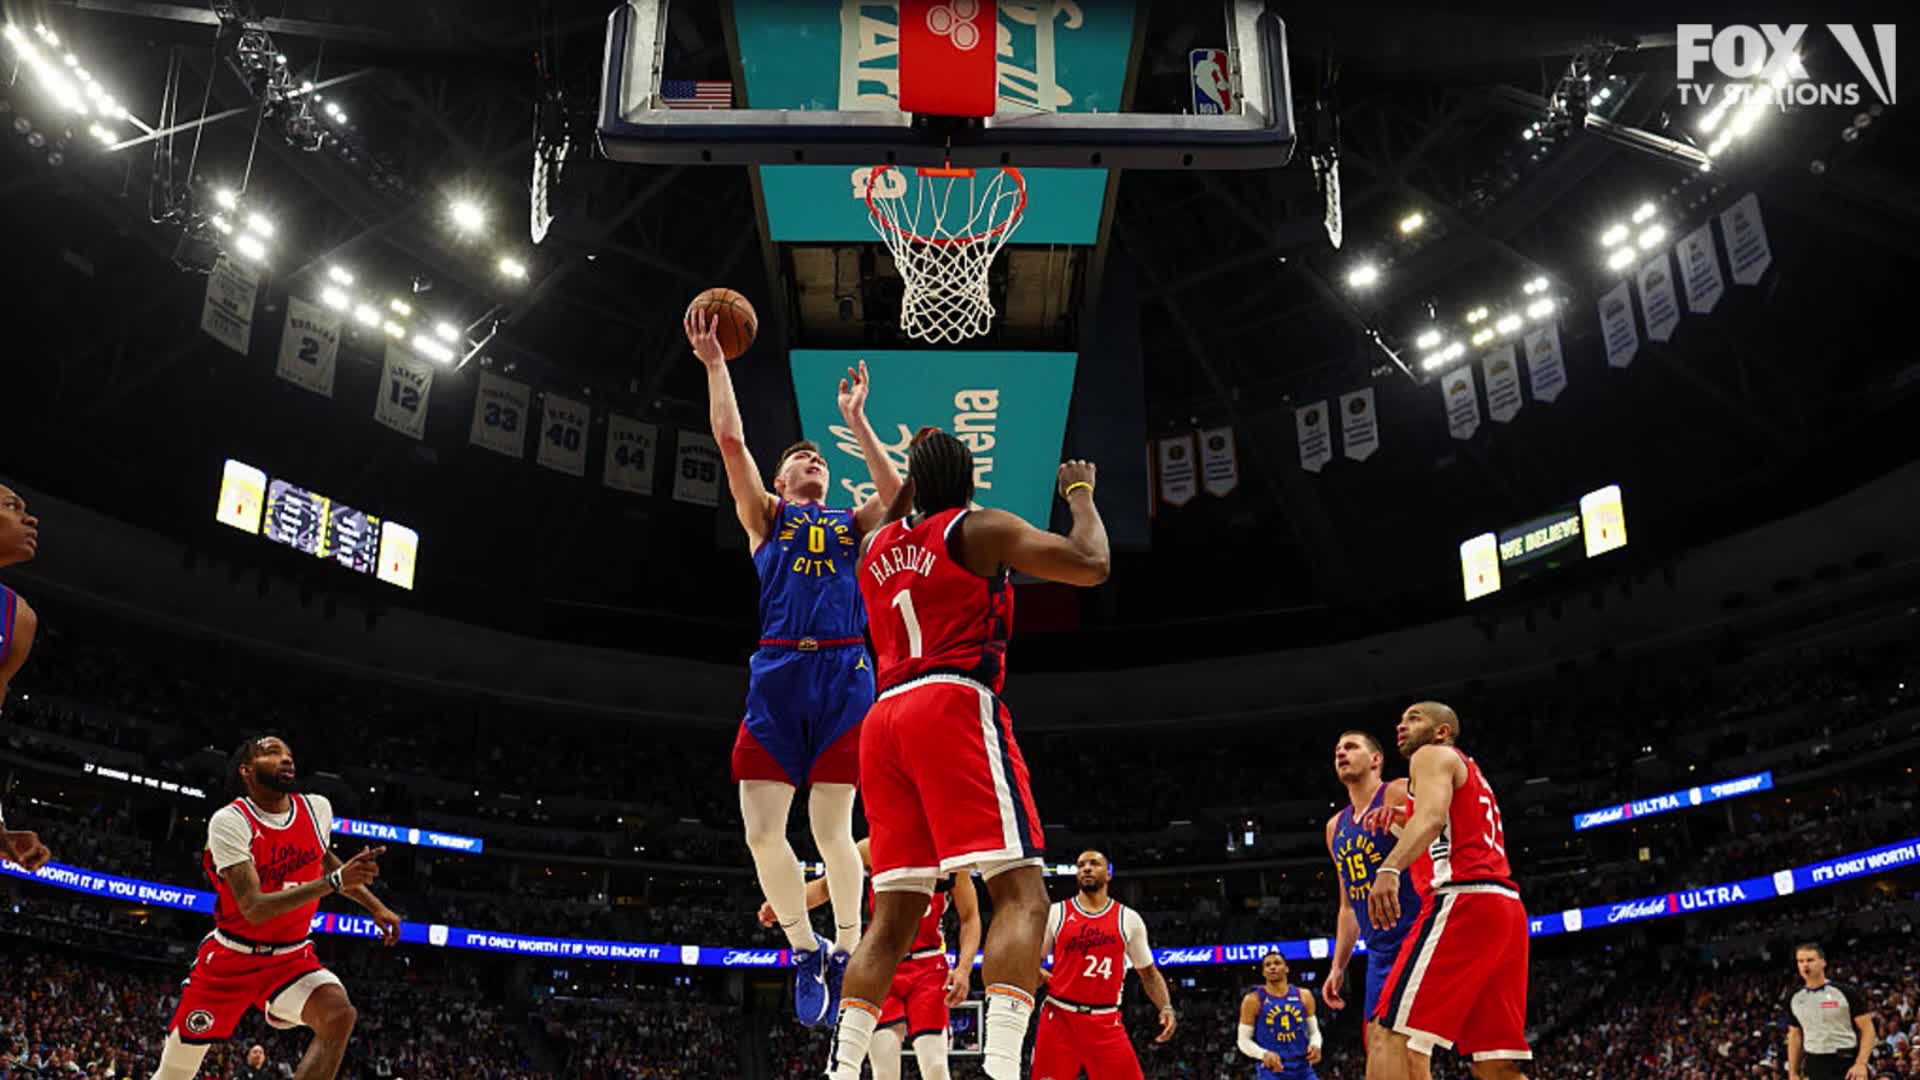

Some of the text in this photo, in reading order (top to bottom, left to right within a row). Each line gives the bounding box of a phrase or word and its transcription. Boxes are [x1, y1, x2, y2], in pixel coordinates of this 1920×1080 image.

[298, 336, 319, 366] 2
[391, 379, 419, 413] 12
[484, 402, 518, 432] 33
[808, 525, 825, 553] 0
[792, 556, 837, 577] CITY
[891, 589, 923, 658] 1
[1632, 795, 1680, 815] ULTRA
[351, 821, 398, 839] ULTRA
[271, 842, 296, 865] Los
[1835, 857, 1866, 876] ONLY
[1867, 845, 1915, 869] WORTH
[1346, 853, 1367, 882] 15
[36, 865, 79, 884] WORTH
[80, 875, 91, 888] IT
[92, 878, 106, 891] IF
[108, 881, 136, 897] YOU
[139, 886, 182, 905] ENJOY
[182, 893, 196, 906] IT
[1680, 885, 1746, 909] ULTRA
[338, 916, 393, 937] ULTR
[1531, 921, 1543, 933] IT
[518, 940, 558, 953] WORTH
[560, 943, 571, 953] IT
[572, 944, 584, 954] IF
[586, 944, 609, 957] YOU
[611, 946, 648, 958] ENJOY
[649, 949, 660, 958] IT
[1083, 954, 1112, 979] 24
[1281, 1014, 1290, 1031] 4
